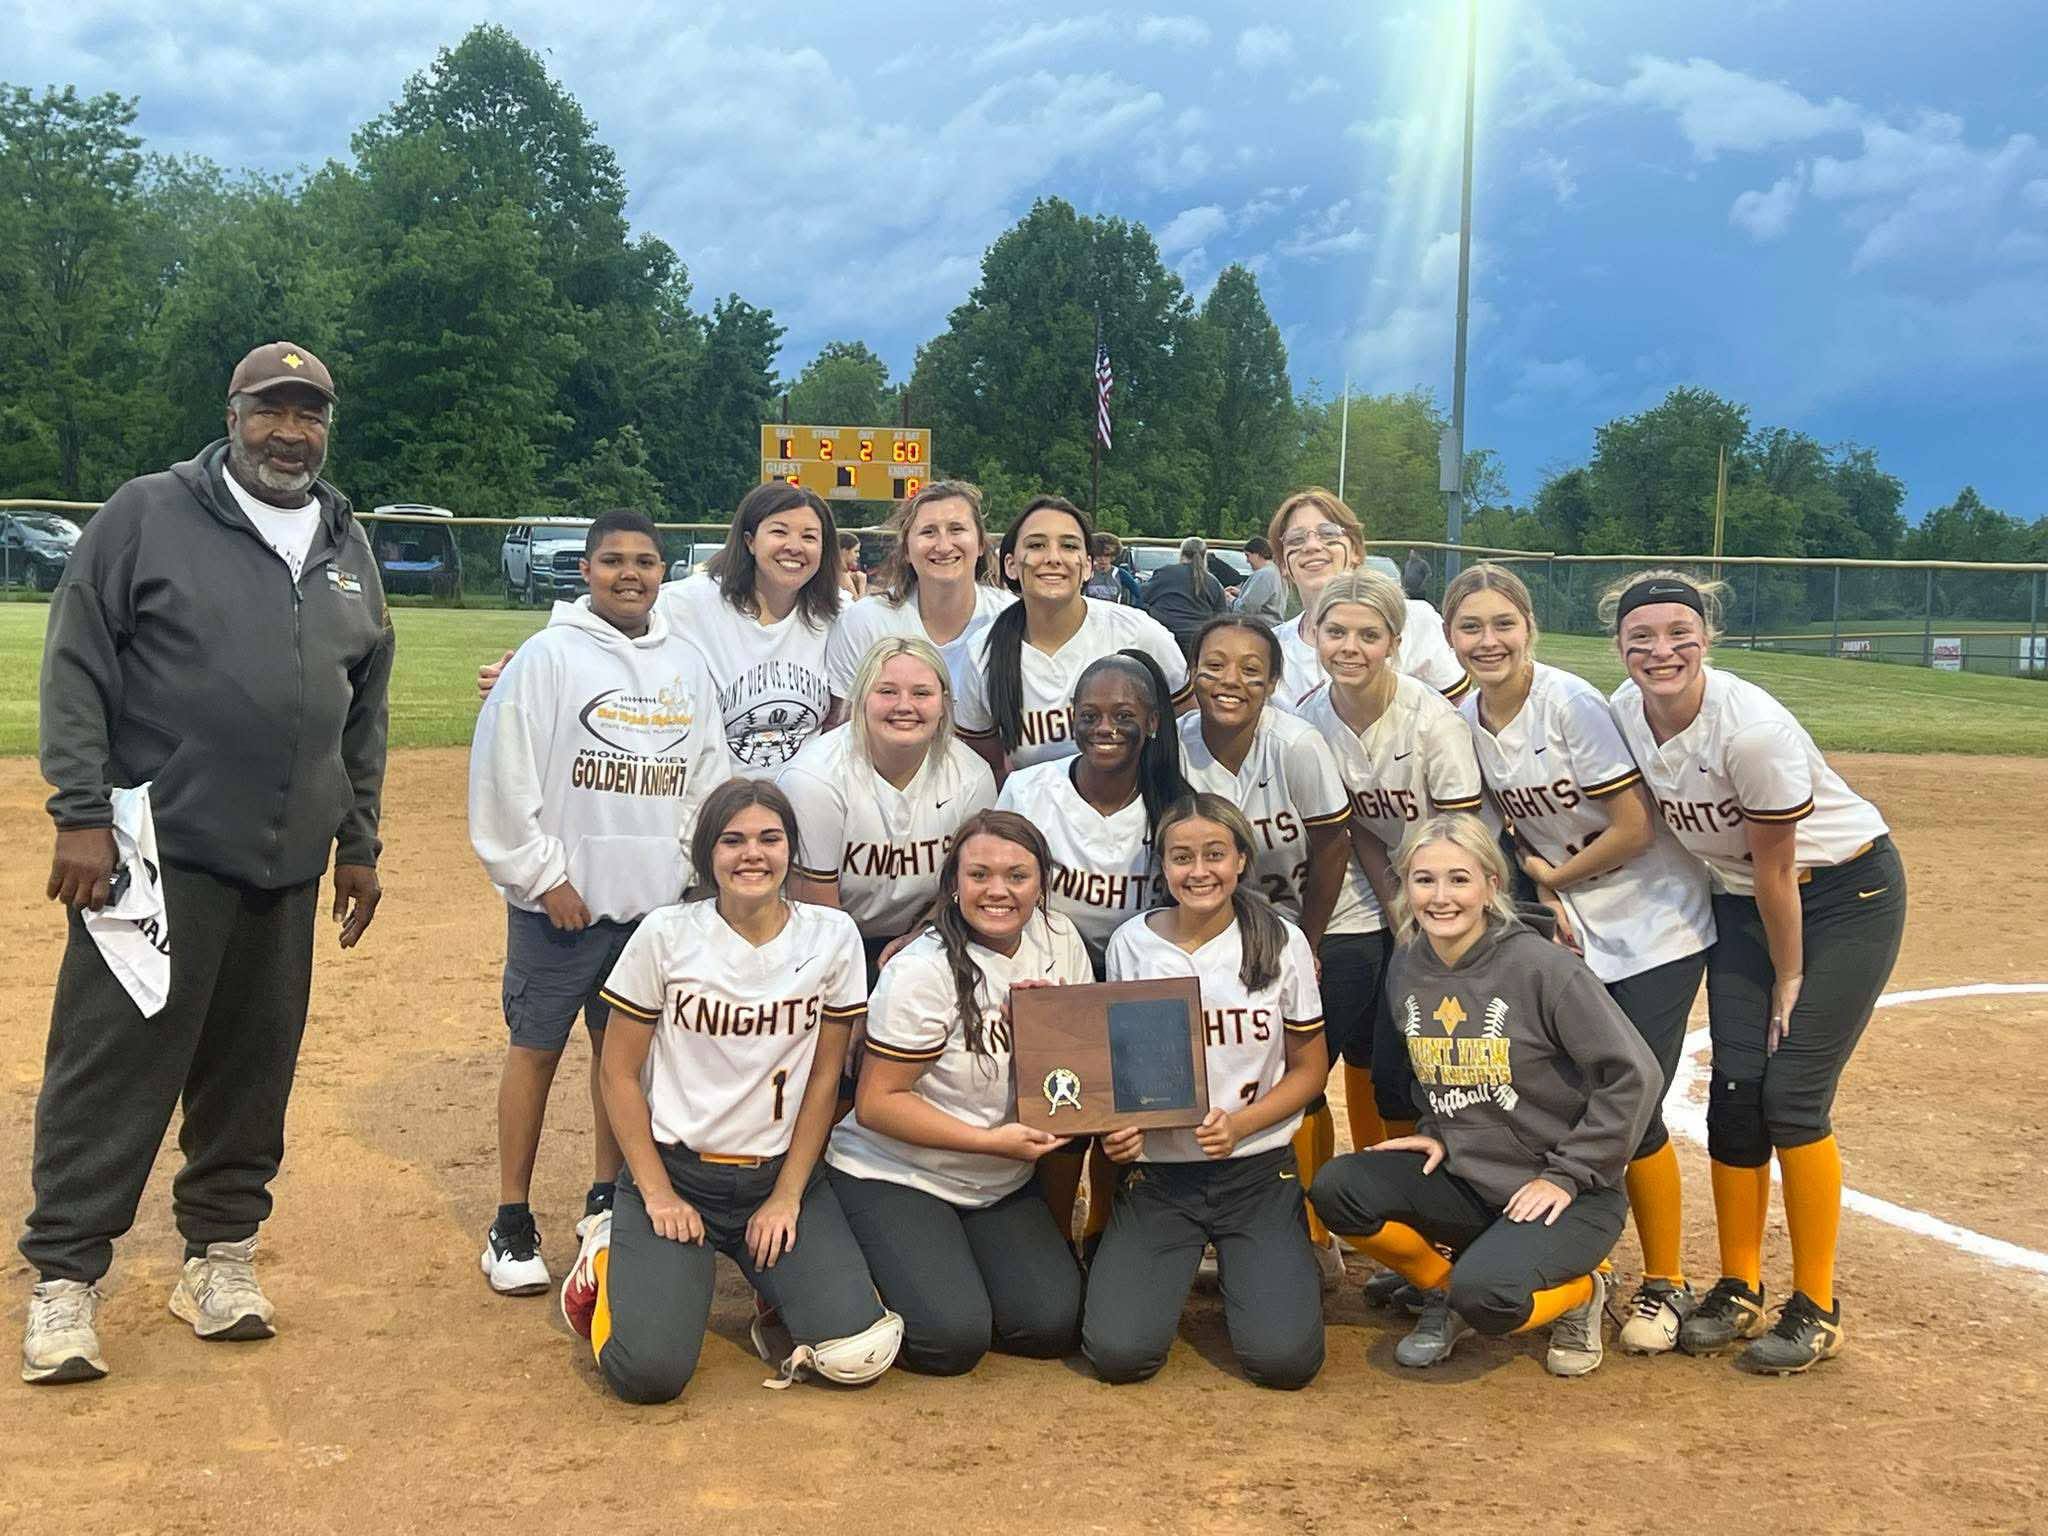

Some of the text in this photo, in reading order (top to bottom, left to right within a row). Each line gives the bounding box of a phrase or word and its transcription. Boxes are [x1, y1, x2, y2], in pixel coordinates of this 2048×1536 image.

[820, 439, 833, 460] 2
[860, 440, 873, 462] 2
[893, 441, 920, 463] 60
[766, 462, 801, 475] GUEST
[580, 748, 649, 763] MOUNT
[572, 756, 687, 797] GOLDEN KNIGHT
[1494, 779, 1580, 820] IGHTS
[674, 989, 819, 1037] KNIGHTS
[1456, 1037, 1511, 1066] VIEW
[772, 1069, 787, 1121] 1
